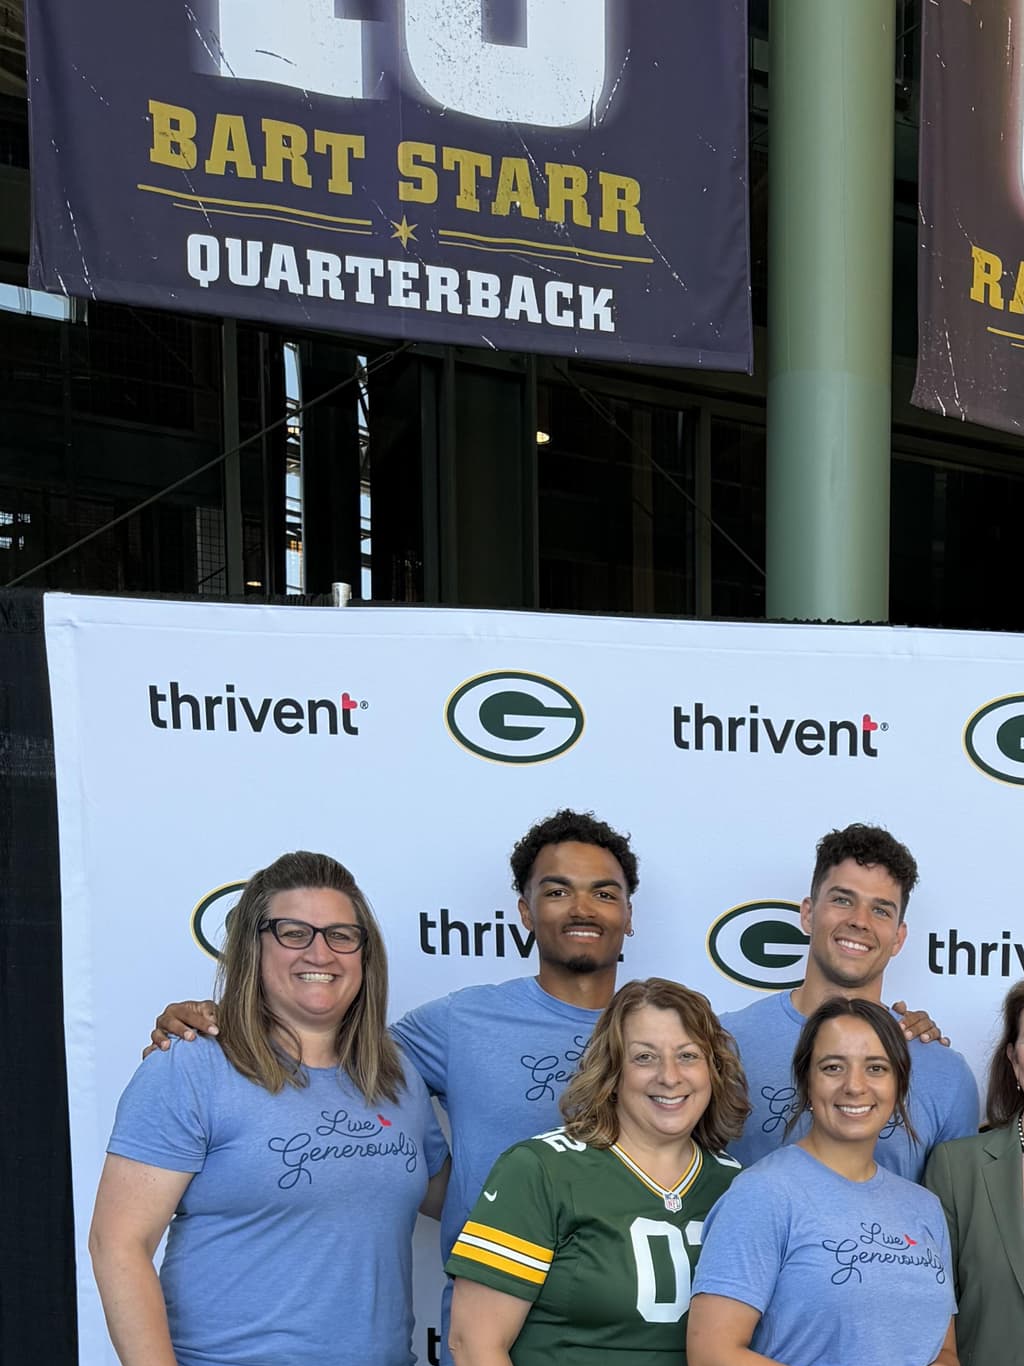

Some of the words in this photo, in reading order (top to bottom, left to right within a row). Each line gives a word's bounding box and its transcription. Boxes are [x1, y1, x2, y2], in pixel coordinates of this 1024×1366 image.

[148, 100, 365, 195] BART
[397, 141, 645, 236] STARR
[187, 233, 616, 332] QUARTERBACK
[316, 1109, 383, 1138] Live
[267, 1132, 418, 1190] Generously
[822, 1239, 946, 1285] Generously
[859, 1222, 911, 1251] Live
